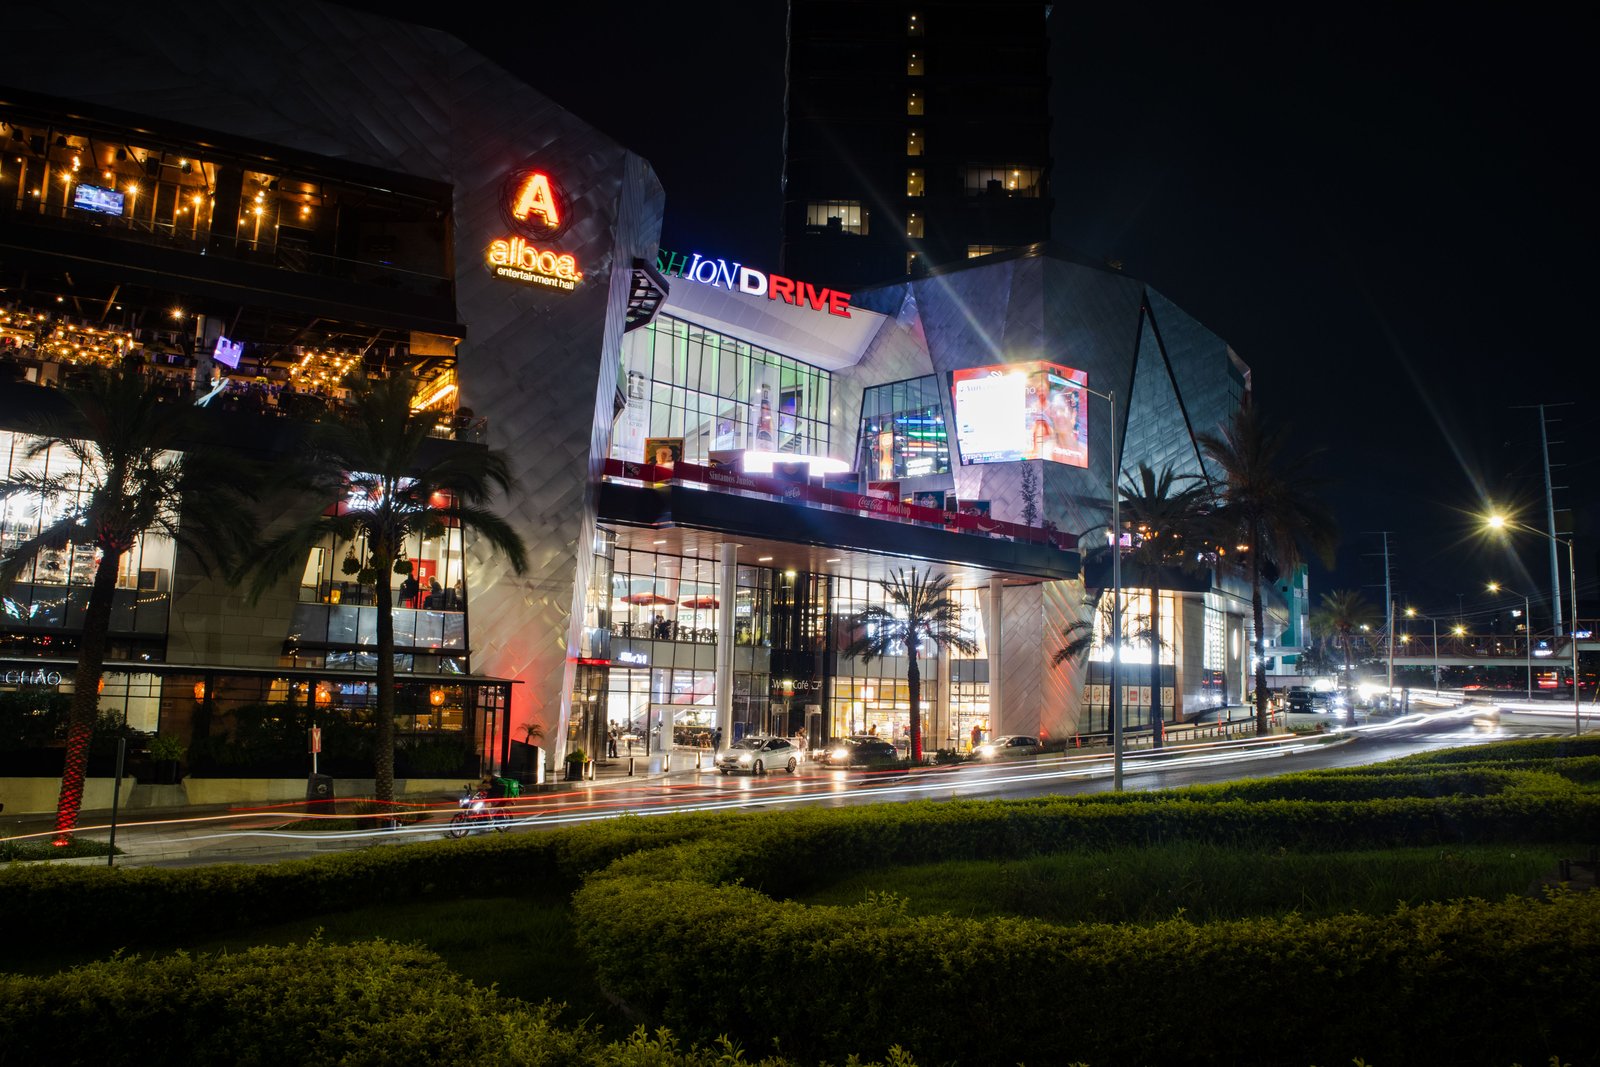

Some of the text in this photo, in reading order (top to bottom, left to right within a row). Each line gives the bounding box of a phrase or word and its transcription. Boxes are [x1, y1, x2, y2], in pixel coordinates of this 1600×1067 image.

[514, 173, 560, 226] A
[497, 267, 575, 290] entertainment hall
[792, 679, 809, 690] Café
